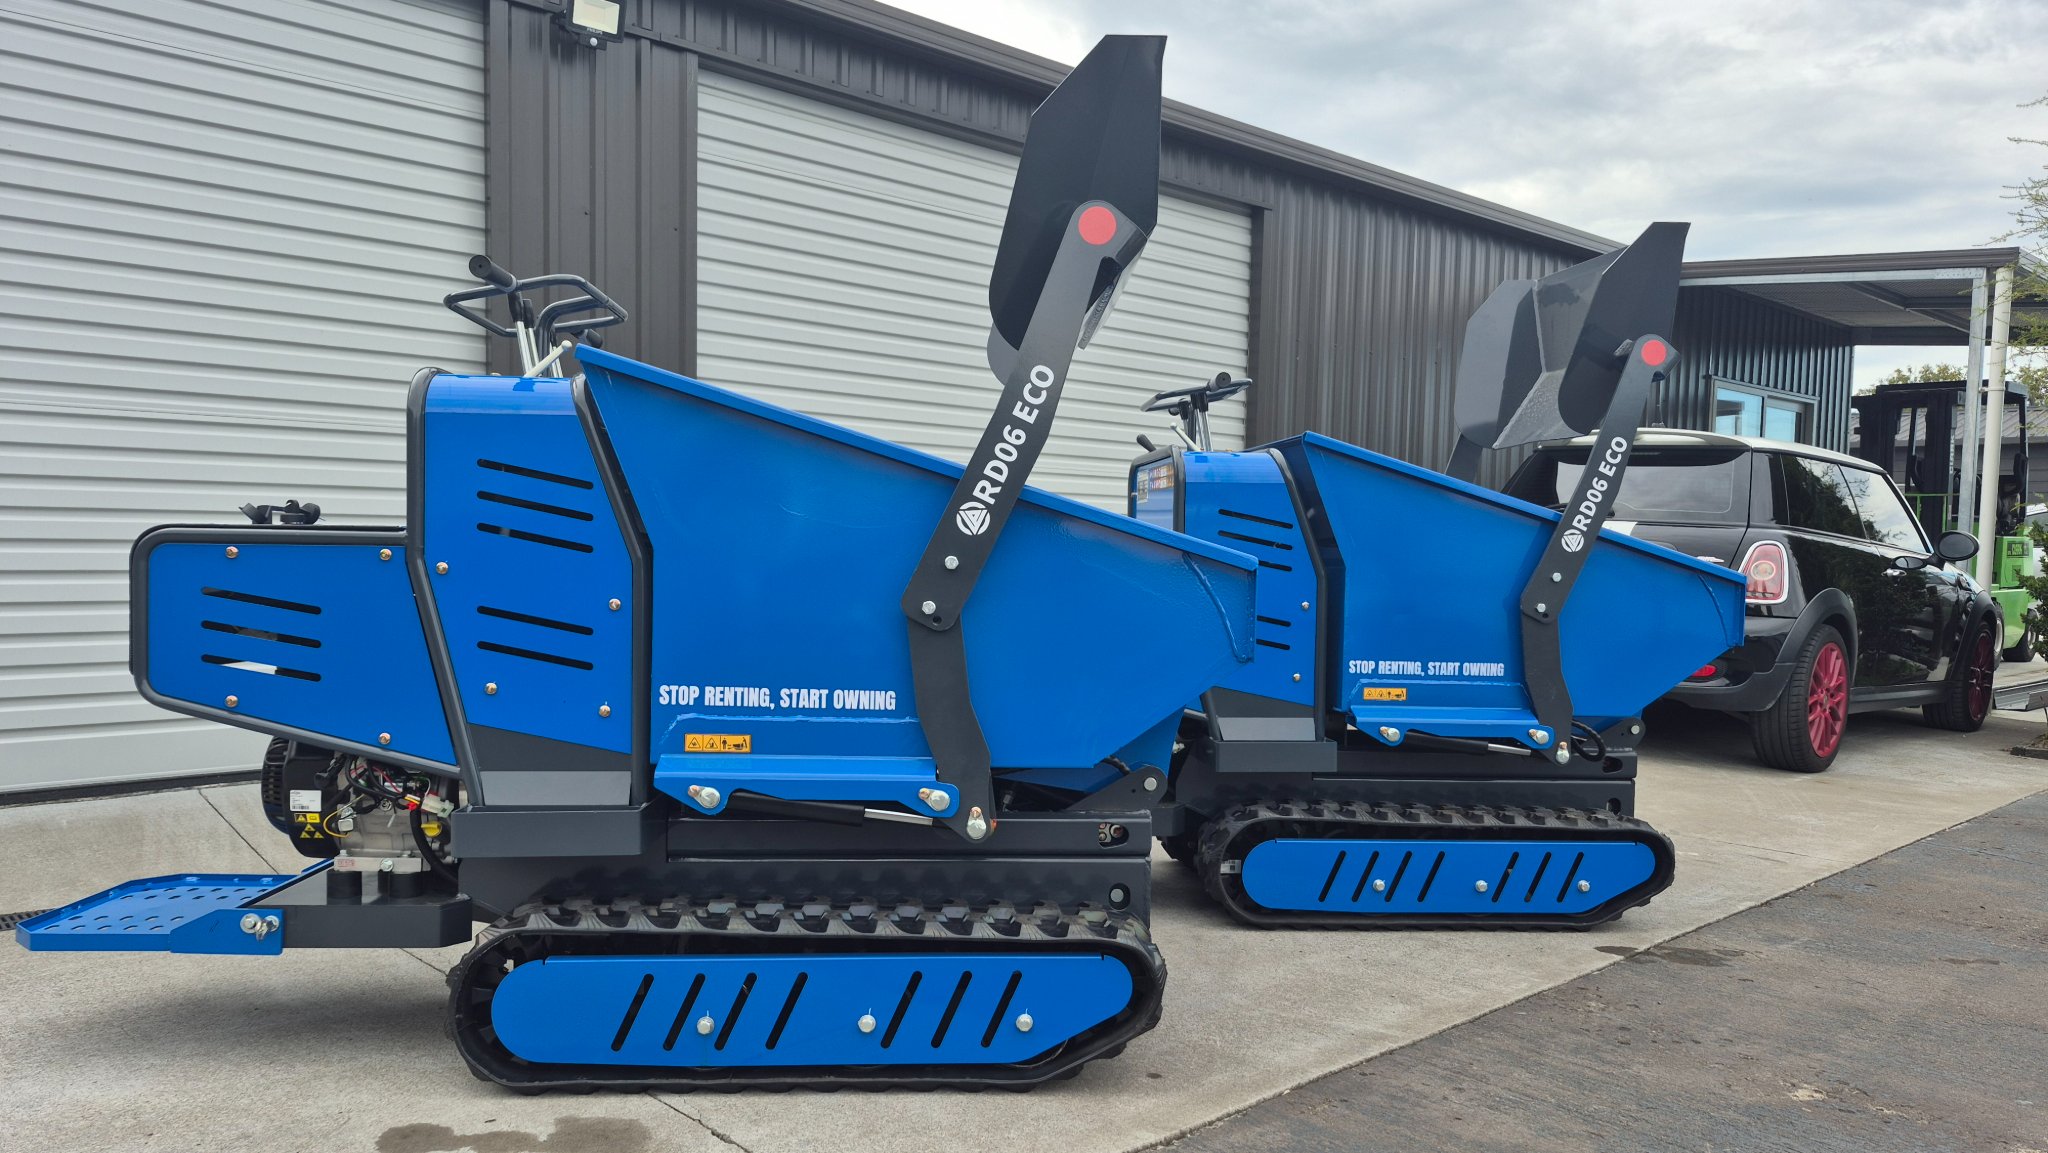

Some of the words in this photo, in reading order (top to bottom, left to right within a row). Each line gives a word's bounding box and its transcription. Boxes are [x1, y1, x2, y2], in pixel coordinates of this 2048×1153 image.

[972, 424, 1027, 505] RD06
[1012, 364, 1055, 425] ECO
[1571, 476, 1609, 532] RD06
[1598, 436, 1628, 477] ECO
[659, 684, 700, 706] STOP
[704, 685, 775, 710] RENTING,
[779, 687, 829, 709] START
[833, 688, 897, 711] OWNING
[1348, 659, 1376, 674] STOP
[1378, 660, 1425, 677] RENTING,
[1427, 661, 1461, 676] START
[1462, 662, 1505, 677] OWNING
